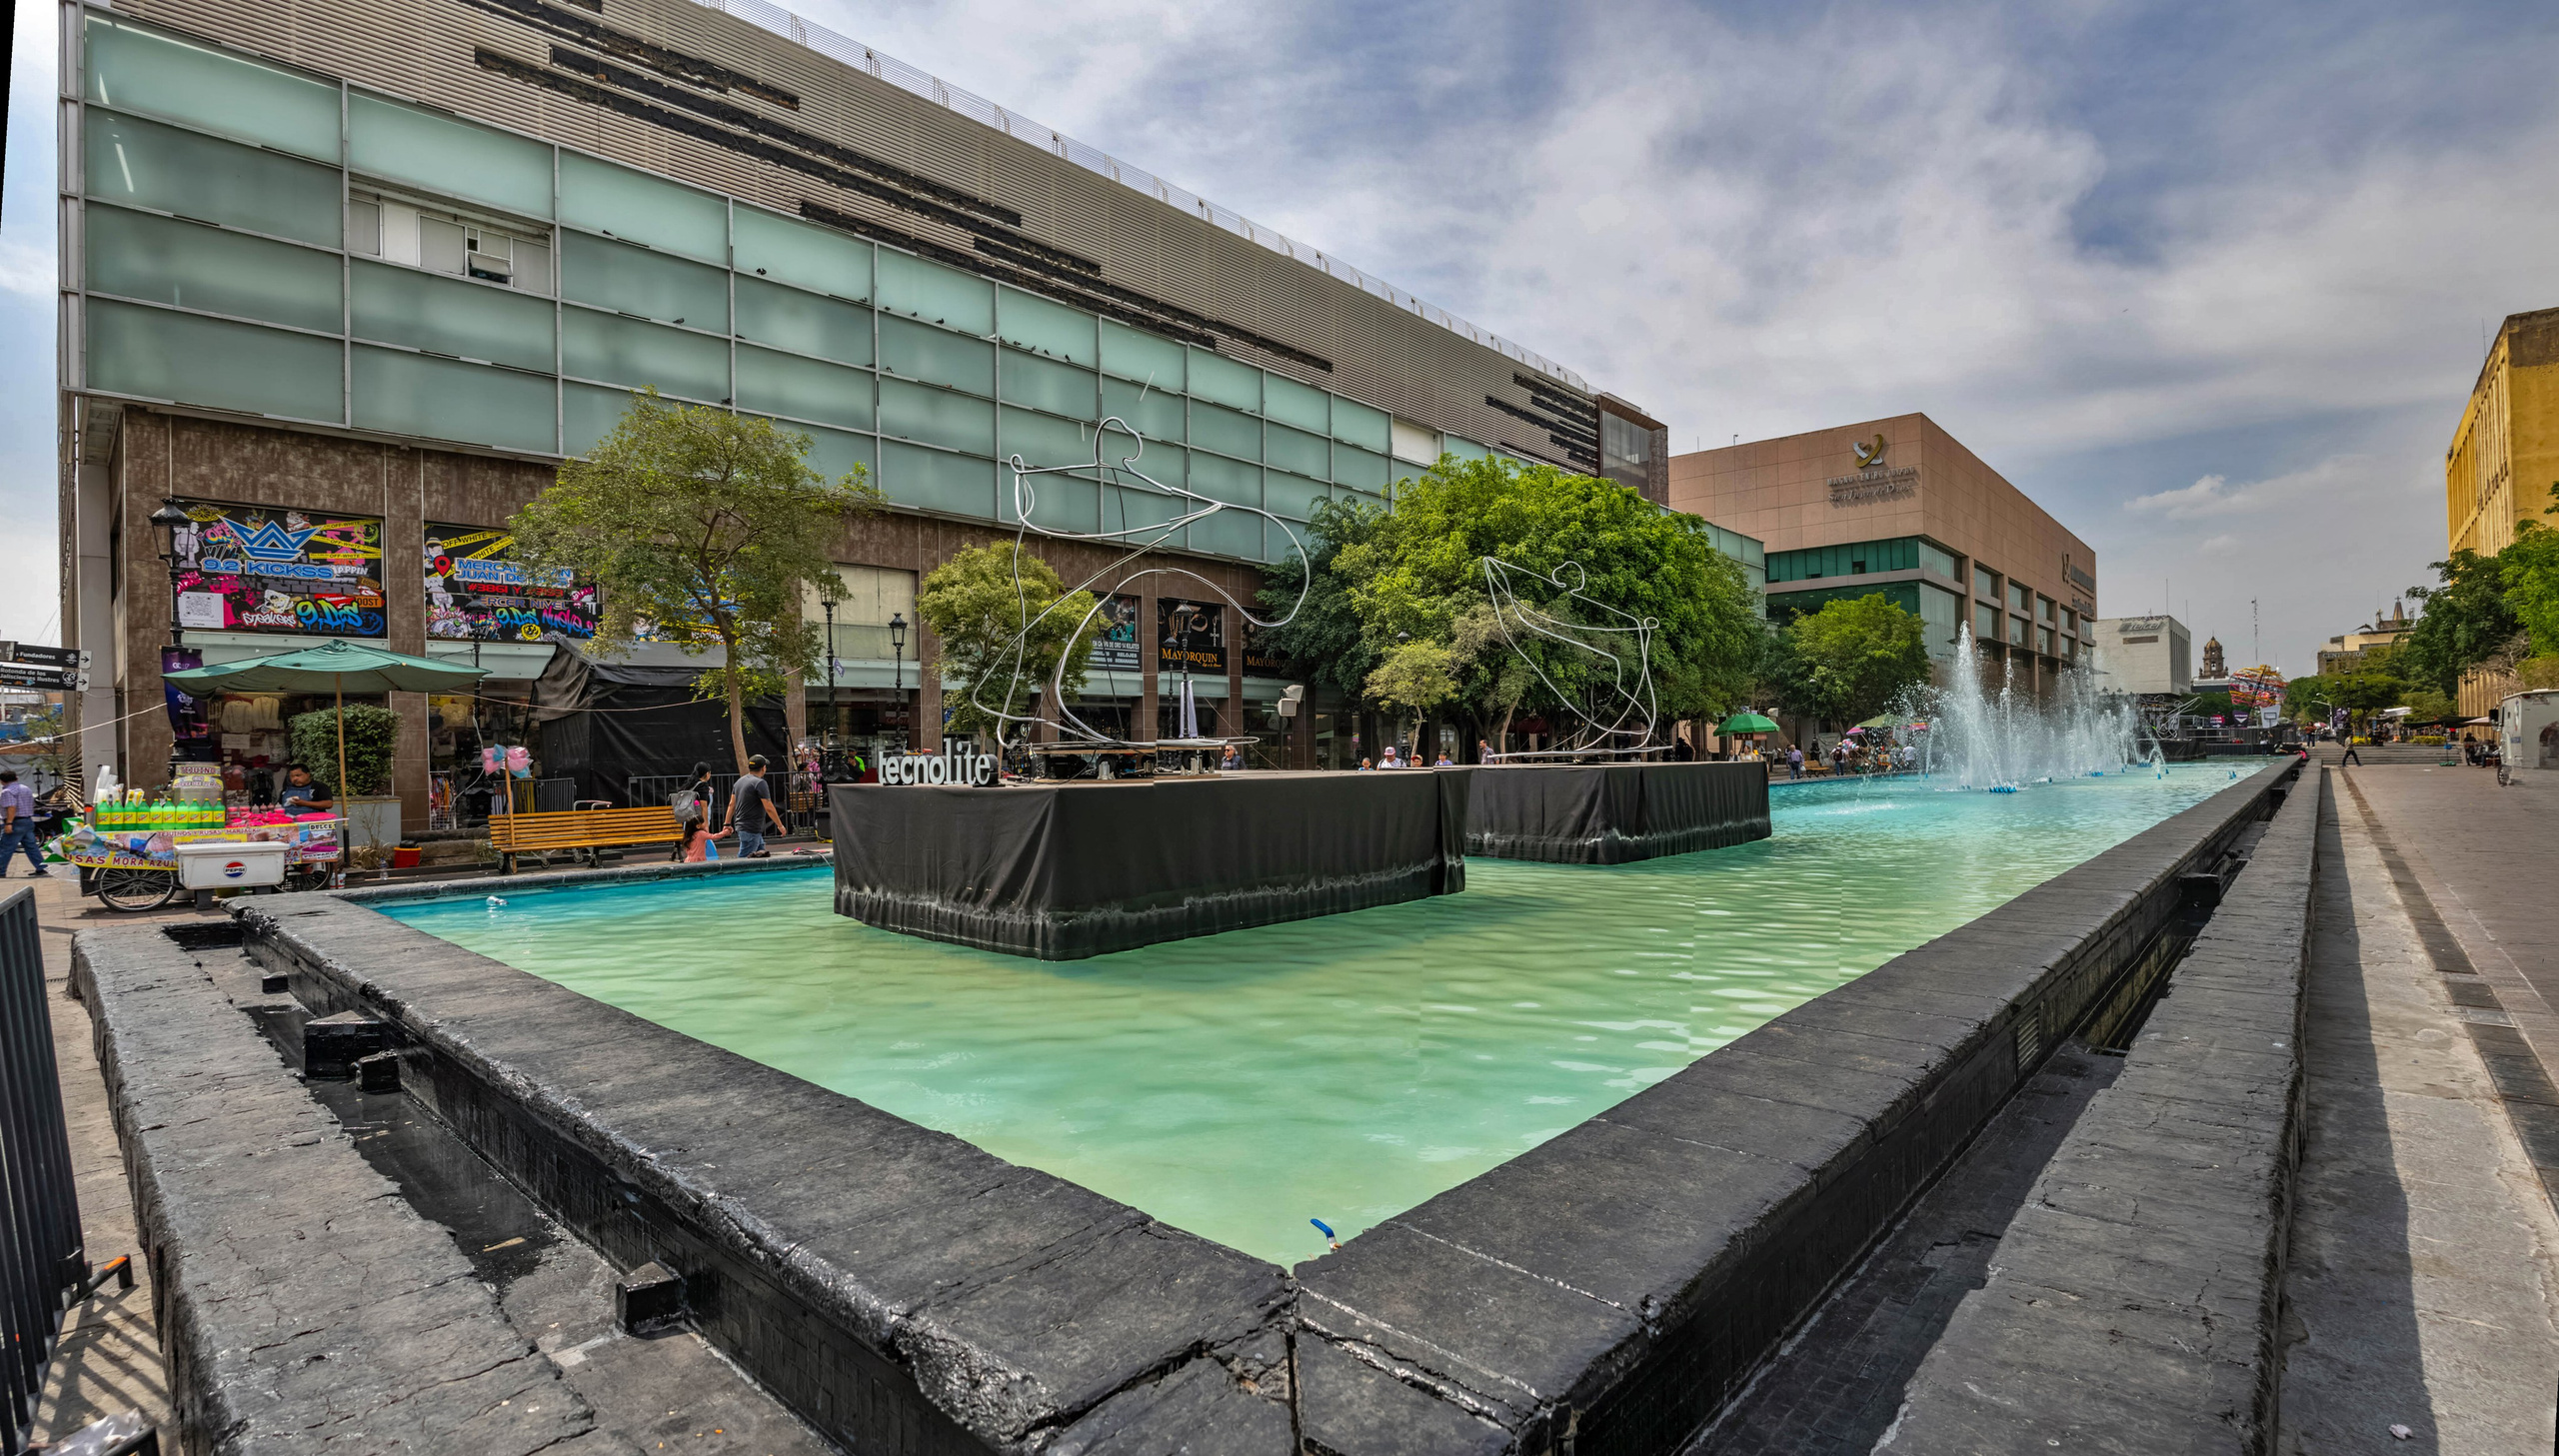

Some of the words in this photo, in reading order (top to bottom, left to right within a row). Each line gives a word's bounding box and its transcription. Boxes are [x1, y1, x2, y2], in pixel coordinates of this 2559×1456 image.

[1826, 475, 1853, 487] MAGNO
[1856, 470, 1884, 482] CENTRO
[1886, 466, 1915, 478] JOYERO
[1828, 492, 1847, 502] San
[1848, 489, 1872, 501] Juan
[1886, 483, 1911, 494] Dios
[330, 539, 362, 550] OFF-WHITE
[202, 559, 240, 573] 9.2
[247, 560, 334, 579] KICKSS
[457, 560, 524, 576] MERCAD
[456, 570, 499, 581] JUAN
[468, 583, 509, 594] #3861
[513, 586, 523, 595] Y
[358, 597, 379, 607] OOST
[480, 597, 526, 609] ERCER
[530, 598, 569, 611] NIVEL
[20, 651, 56, 660] Fundadores
[1162, 647, 1219, 664] MAYORQUIN
[1247, 655, 1286, 669] MAYORQU
[0, 667, 26, 676] Rotonda
[879, 737, 991, 785] tecnolite
[181, 765, 217, 774] TEJUINO
[64, 853, 106, 864] USAS
[112, 856, 144, 866] MORA
[149, 858, 177, 868] AZUL
